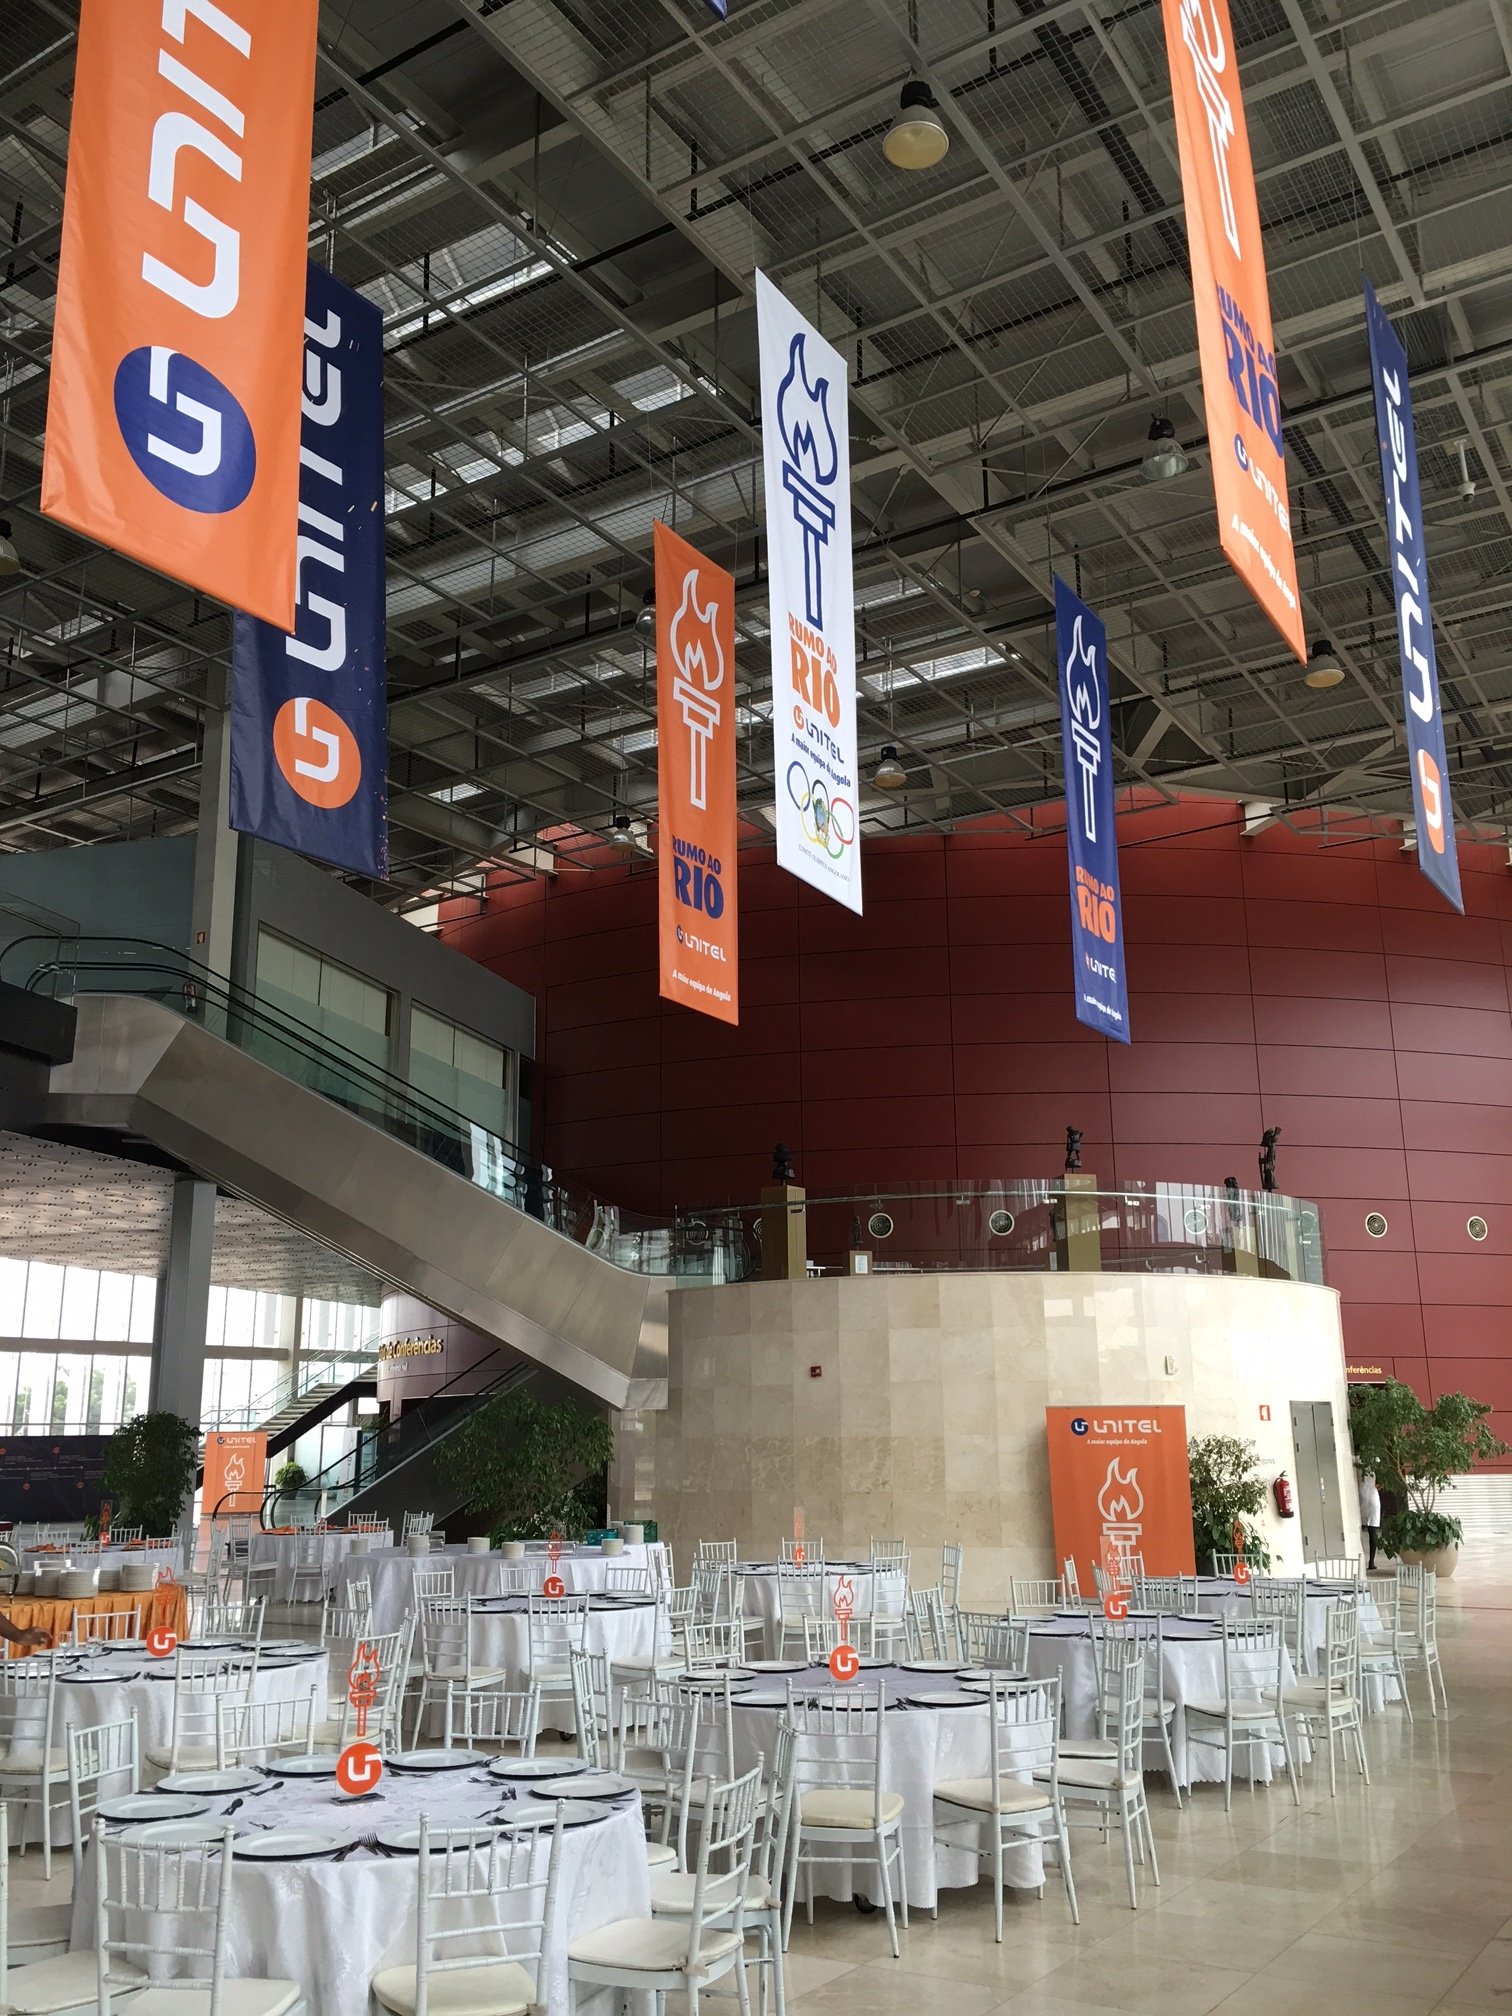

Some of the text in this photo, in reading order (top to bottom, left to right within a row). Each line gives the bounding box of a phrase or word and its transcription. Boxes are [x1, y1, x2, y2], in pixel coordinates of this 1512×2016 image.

[1222, 315, 1284, 459] RIO
[788, 610, 837, 675] RUMO AO
[790, 636, 841, 728] RIO
[805, 717, 845, 764] UNITEL
[672, 833, 722, 875] RUMO AO
[673, 855, 725, 919] RIO
[1100, 882, 1115, 902] AO
[1076, 885, 1116, 944] RIO
[685, 932, 727, 962] UNITEL
[226, 1436, 257, 1444] UNITEL
[1093, 1419, 1162, 1434] UNITEL
[1130, 1438, 1148, 1446] Angola
